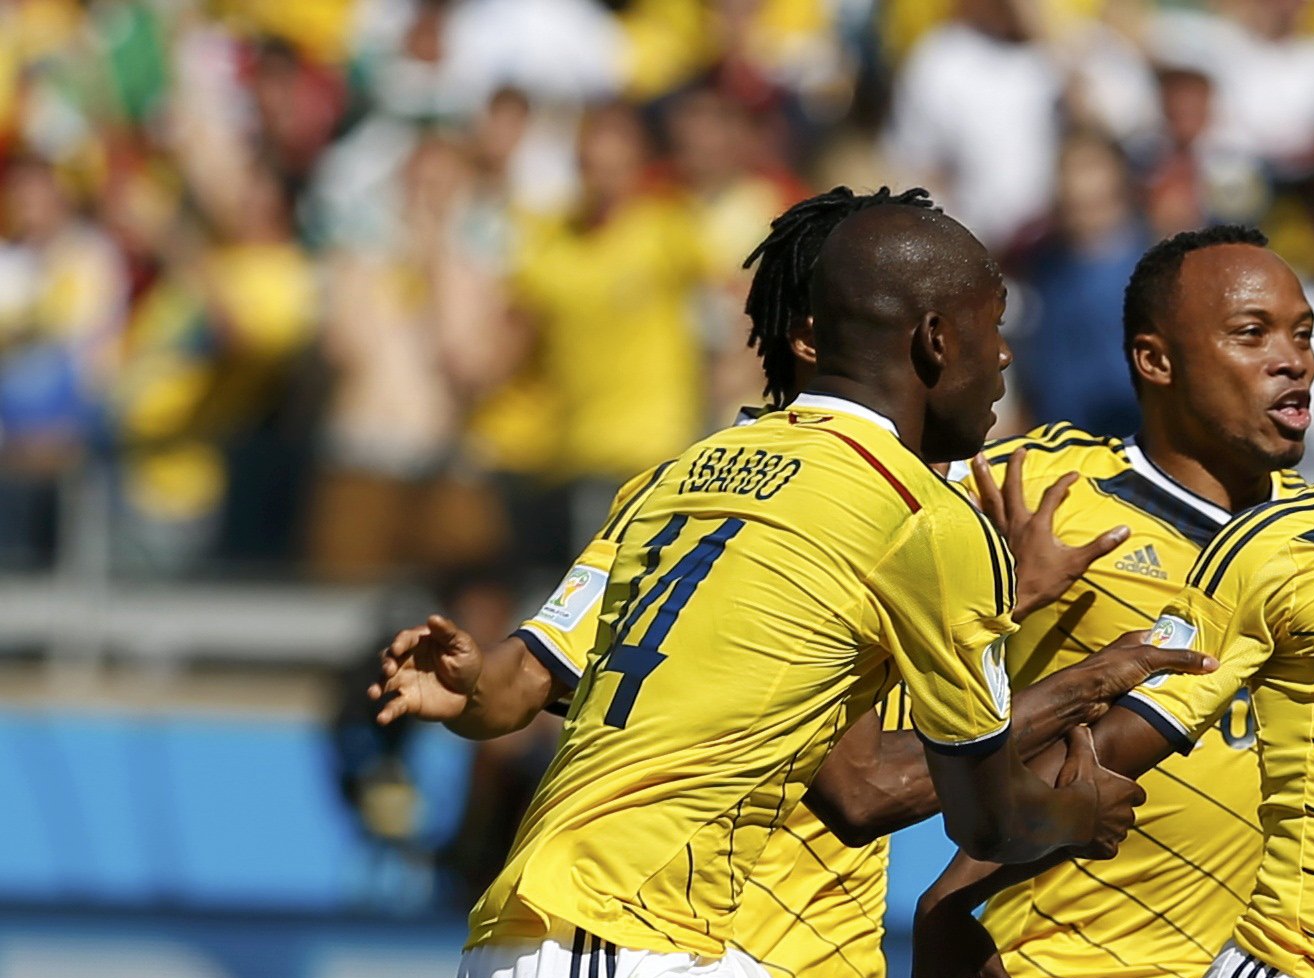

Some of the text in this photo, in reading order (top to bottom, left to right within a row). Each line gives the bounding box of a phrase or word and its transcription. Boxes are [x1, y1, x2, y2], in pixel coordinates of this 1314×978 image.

[678, 447, 801, 500] IBARBO
[1114, 559, 1168, 580] adidas
[591, 513, 746, 730] 14
